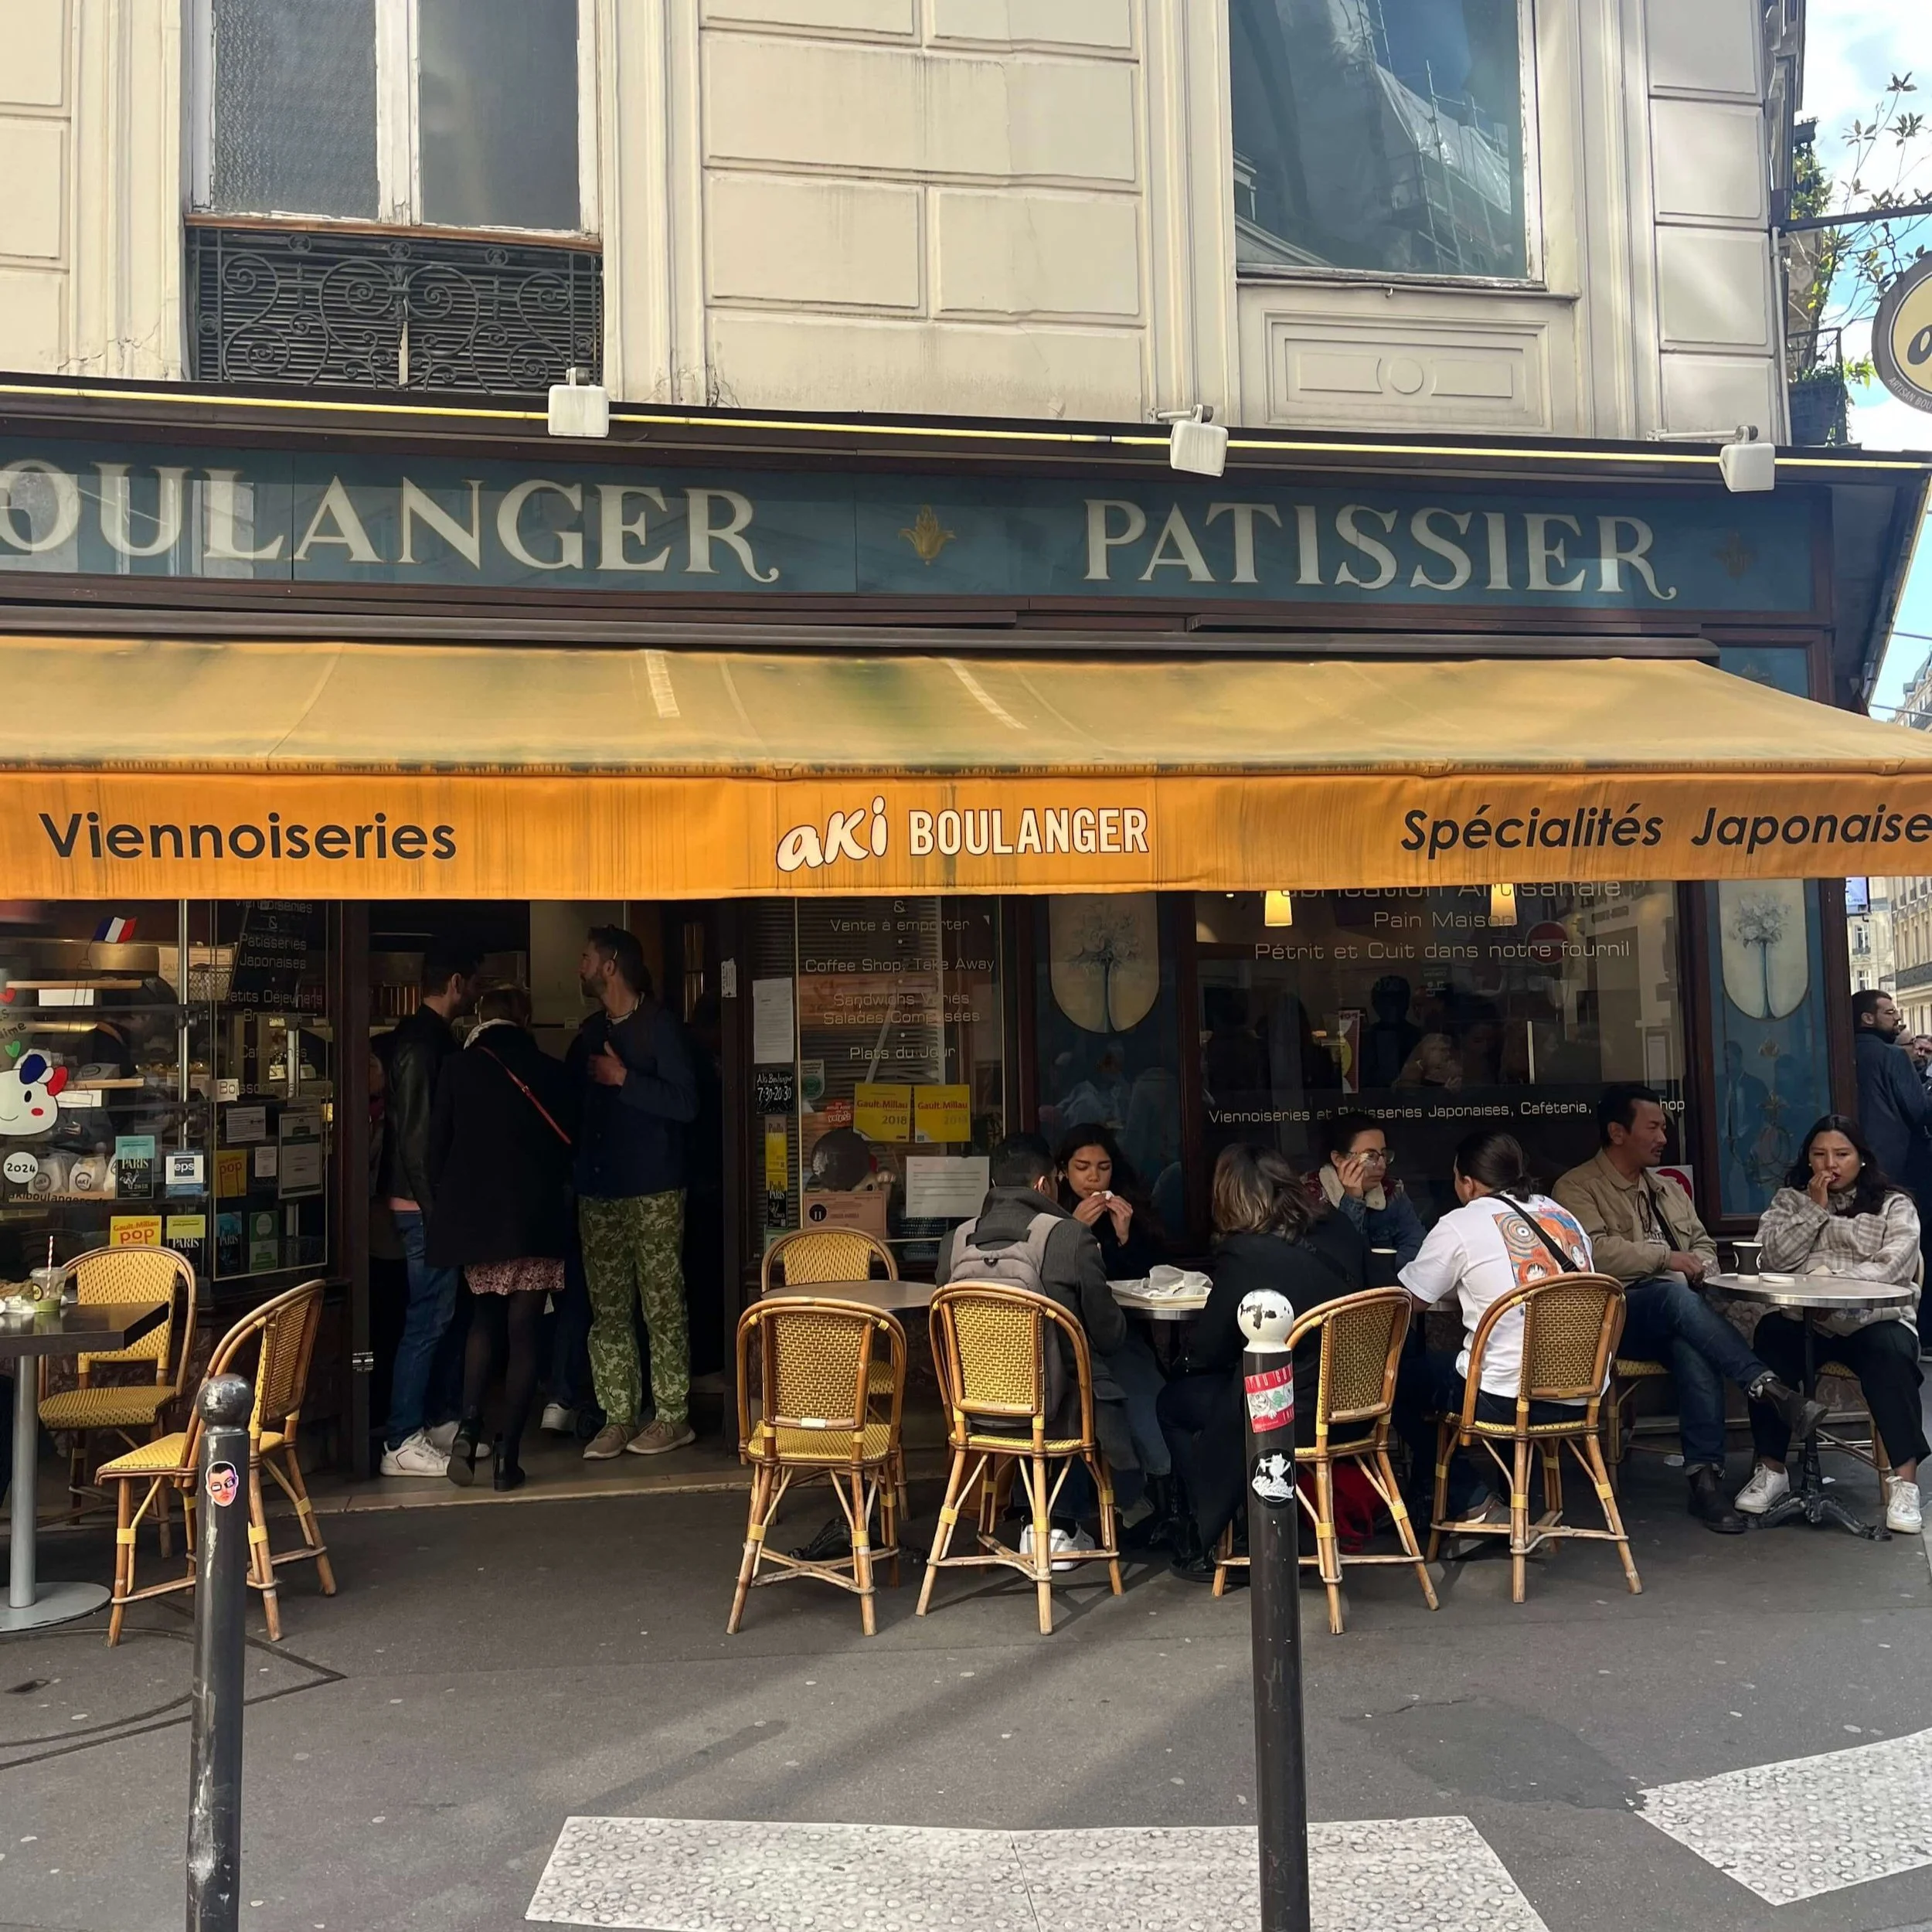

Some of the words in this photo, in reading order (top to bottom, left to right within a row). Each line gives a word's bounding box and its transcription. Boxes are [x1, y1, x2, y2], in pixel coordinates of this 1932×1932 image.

[1888, 377, 1916, 403] ARTISAN
[1083, 498, 1677, 600] PATISSIER
[38, 811, 457, 860] Viennoiseries
[908, 808, 1149, 855] BOULANGER
[1400, 803, 1664, 859] Spécialités
[1690, 804, 1932, 855] Japonaise
[893, 900, 906, 913] &
[829, 918, 876, 932] Vente
[1373, 911, 1422, 928] Pain
[1431, 910, 1516, 928] Maison
[1254, 942, 1325, 961] Pétrit
[1334, 944, 1359, 960] et
[1367, 941, 1415, 960] Cuit
[1424, 940, 1478, 959] dans
[1489, 942, 1552, 959] notre
[1558, 940, 1631, 958] fournil
[805, 958, 856, 972] Coffee
[913, 957, 949, 971] Take
[954, 957, 995, 972] Away
[823, 1012, 884, 1026] Salades
[850, 1046, 889, 1060] Plats
[896, 1046, 915, 1060] du
[882, 1115, 907, 1125] 2018
[1208, 1108, 1311, 1124] Viennoiseries
[1316, 1109, 1333, 1121] et
[1427, 1103, 1515, 1121] Japonaises,
[6, 1162, 36, 1174] 2024
[121, 1158, 149, 1170] PARIS
[174, 1162, 196, 1173] eps
[120, 1229, 155, 1244] pop
